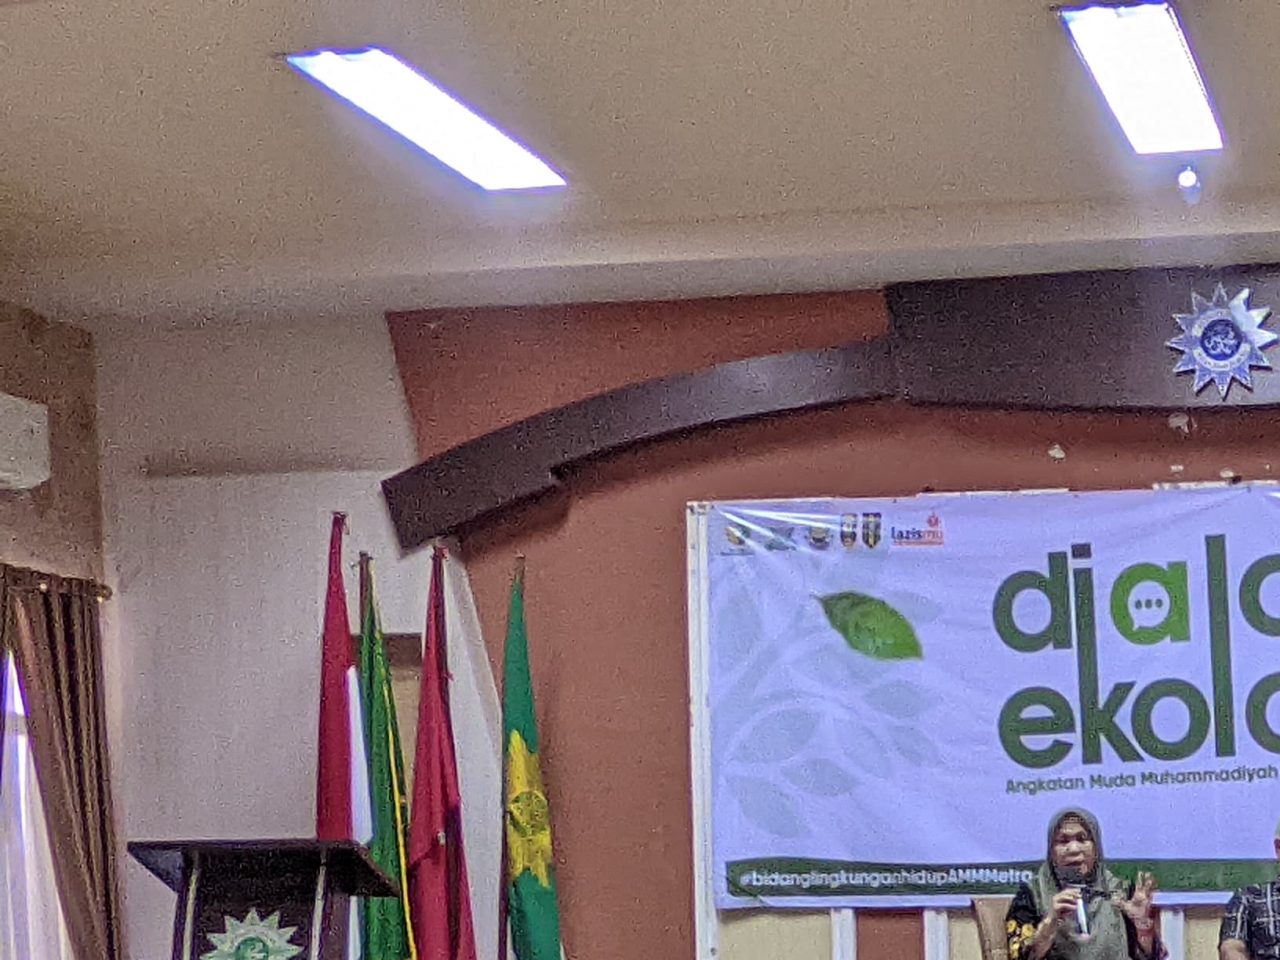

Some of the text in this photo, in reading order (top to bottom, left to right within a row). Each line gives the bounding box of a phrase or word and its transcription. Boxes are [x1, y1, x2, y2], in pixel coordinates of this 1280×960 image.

[1006, 778, 1085, 796] Angkatan
[1090, 774, 1136, 789] Muda
[1141, 766, 1278, 785] Muhammadiyah
